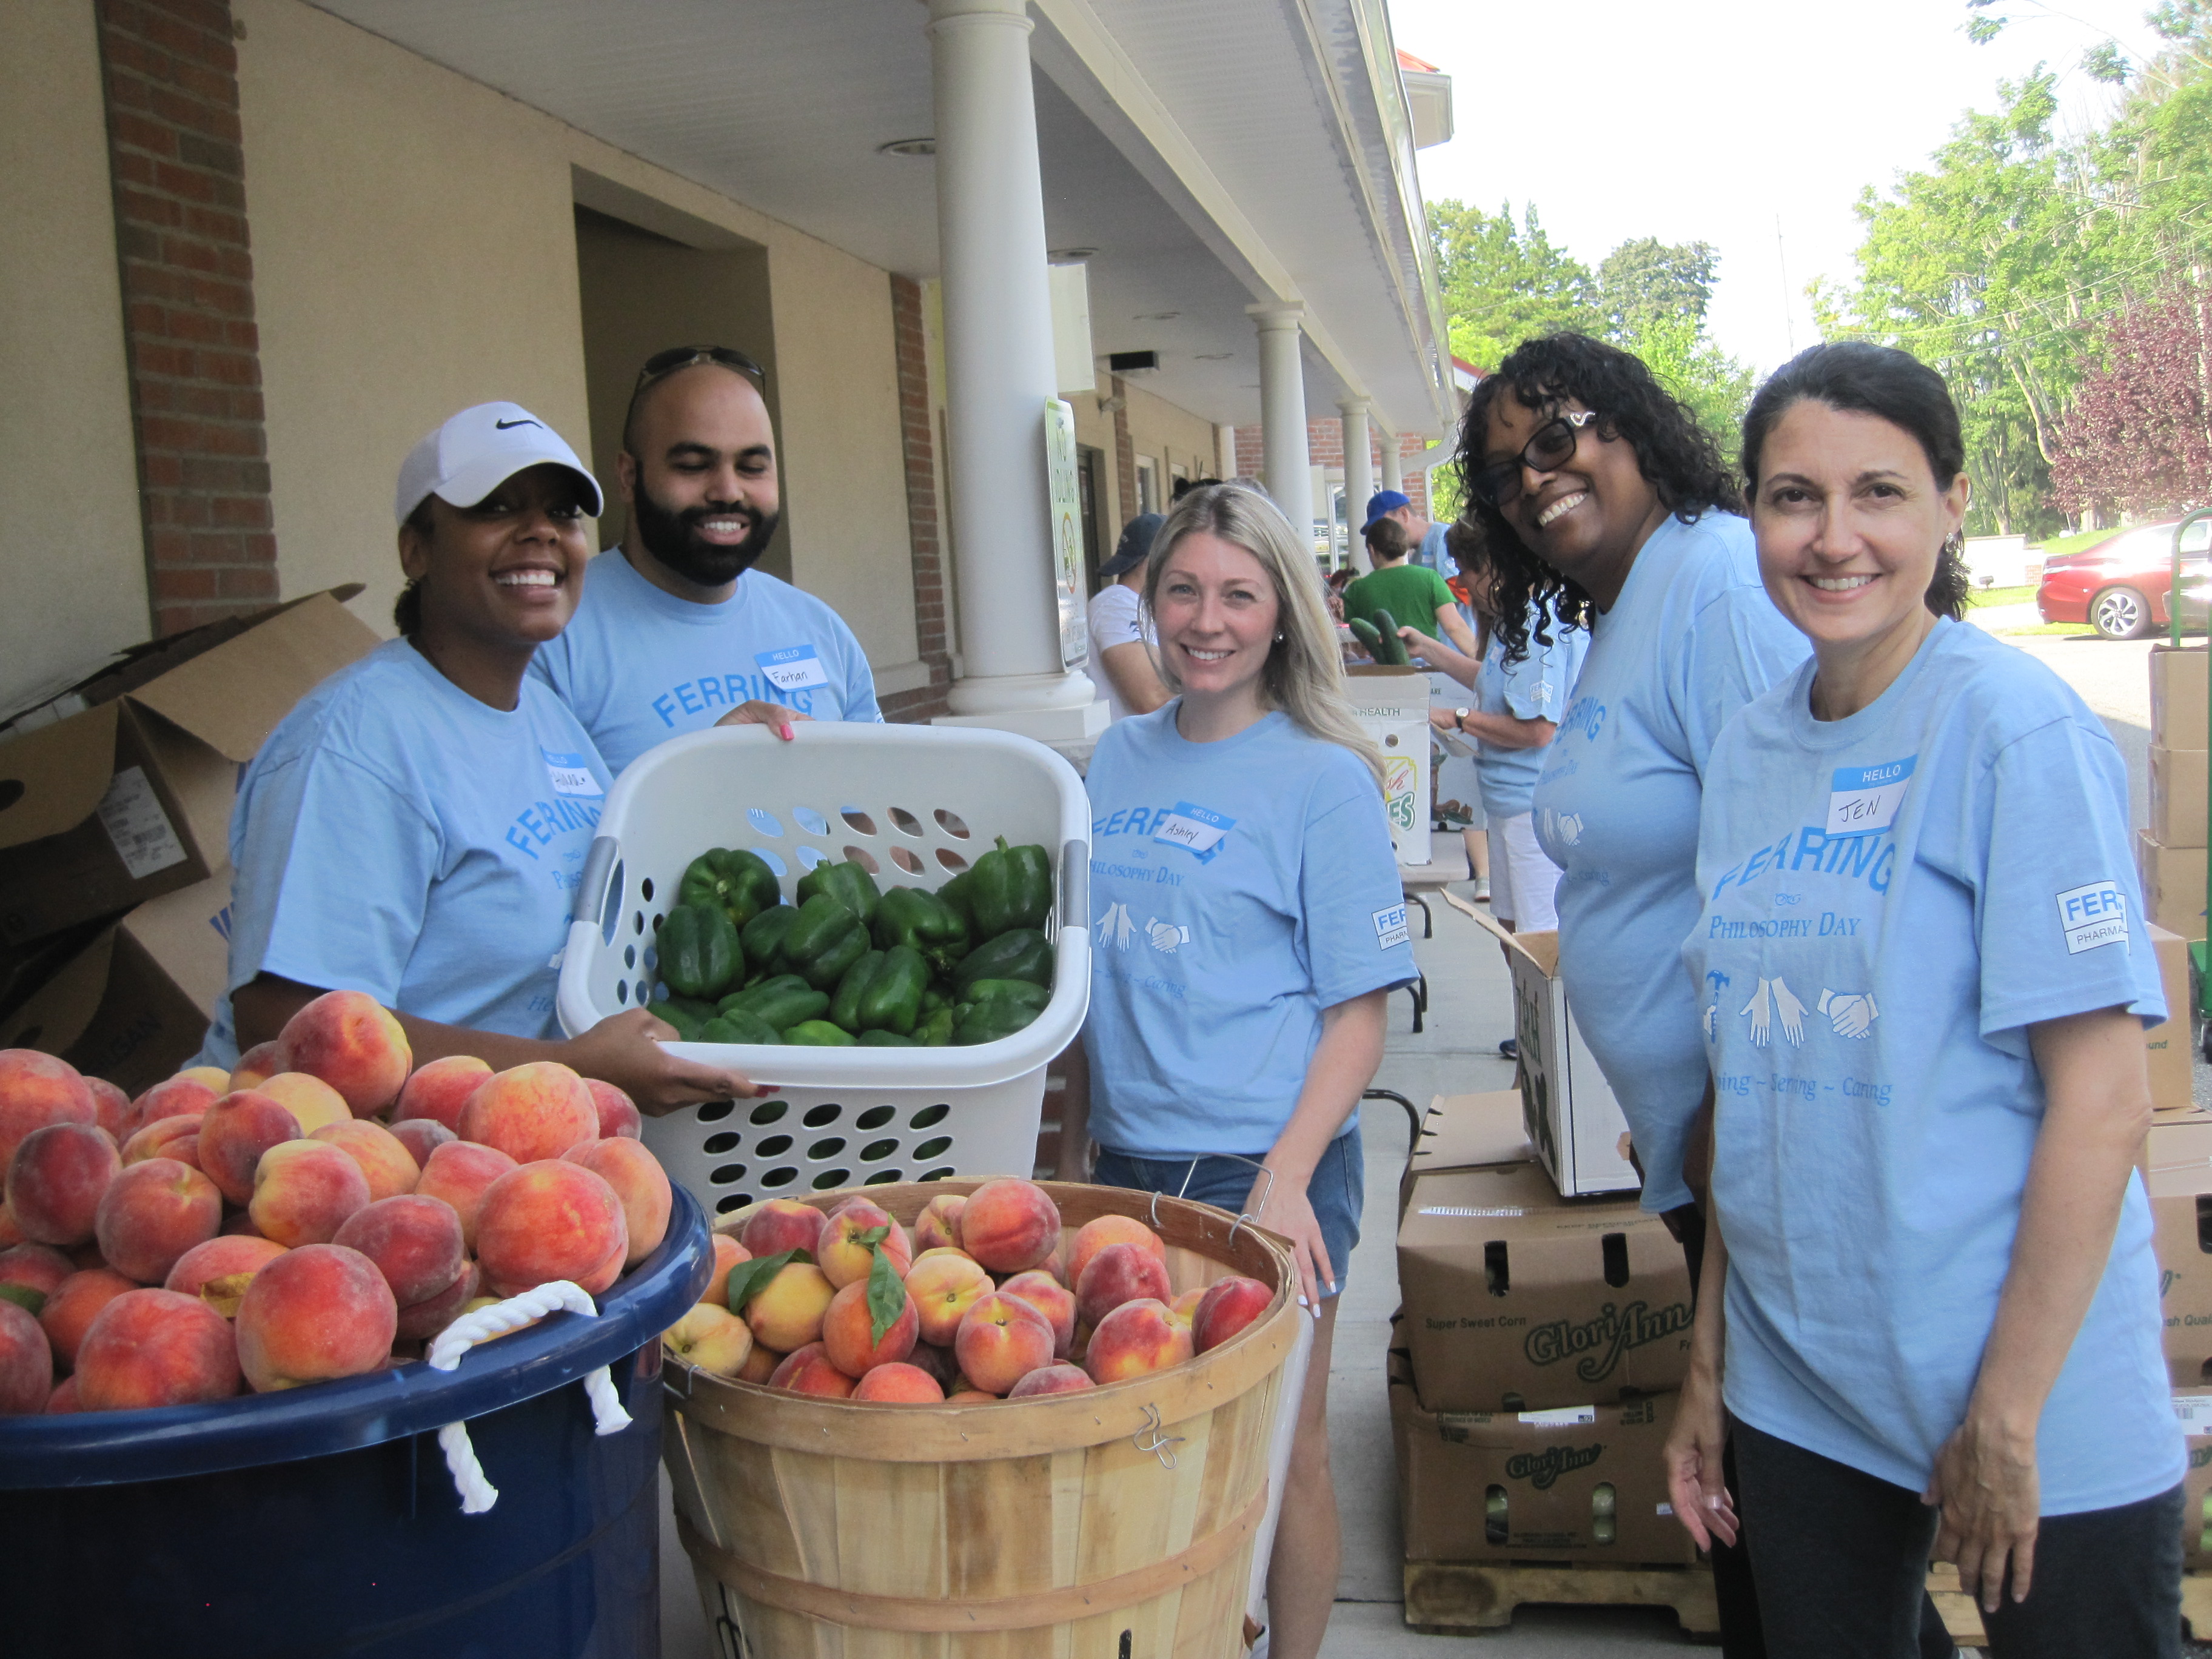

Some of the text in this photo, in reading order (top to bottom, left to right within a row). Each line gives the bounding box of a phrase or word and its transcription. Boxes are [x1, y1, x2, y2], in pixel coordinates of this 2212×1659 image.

[773, 649, 799, 660] HELLO
[1360, 708, 1401, 717] HEALTH
[1862, 765, 1901, 782] HELLO
[1190, 808, 1219, 823] HELLO
[1838, 795, 1881, 822] JEN
[1165, 823, 1199, 845] Ashley
[1090, 860, 1185, 887] HILOSOPHY DAY
[1712, 826, 1897, 902] FERRING
[1709, 911, 1862, 939] PHILOSOPHY DAY
[1426, 1316, 1526, 1331] Super Sweet Corn
